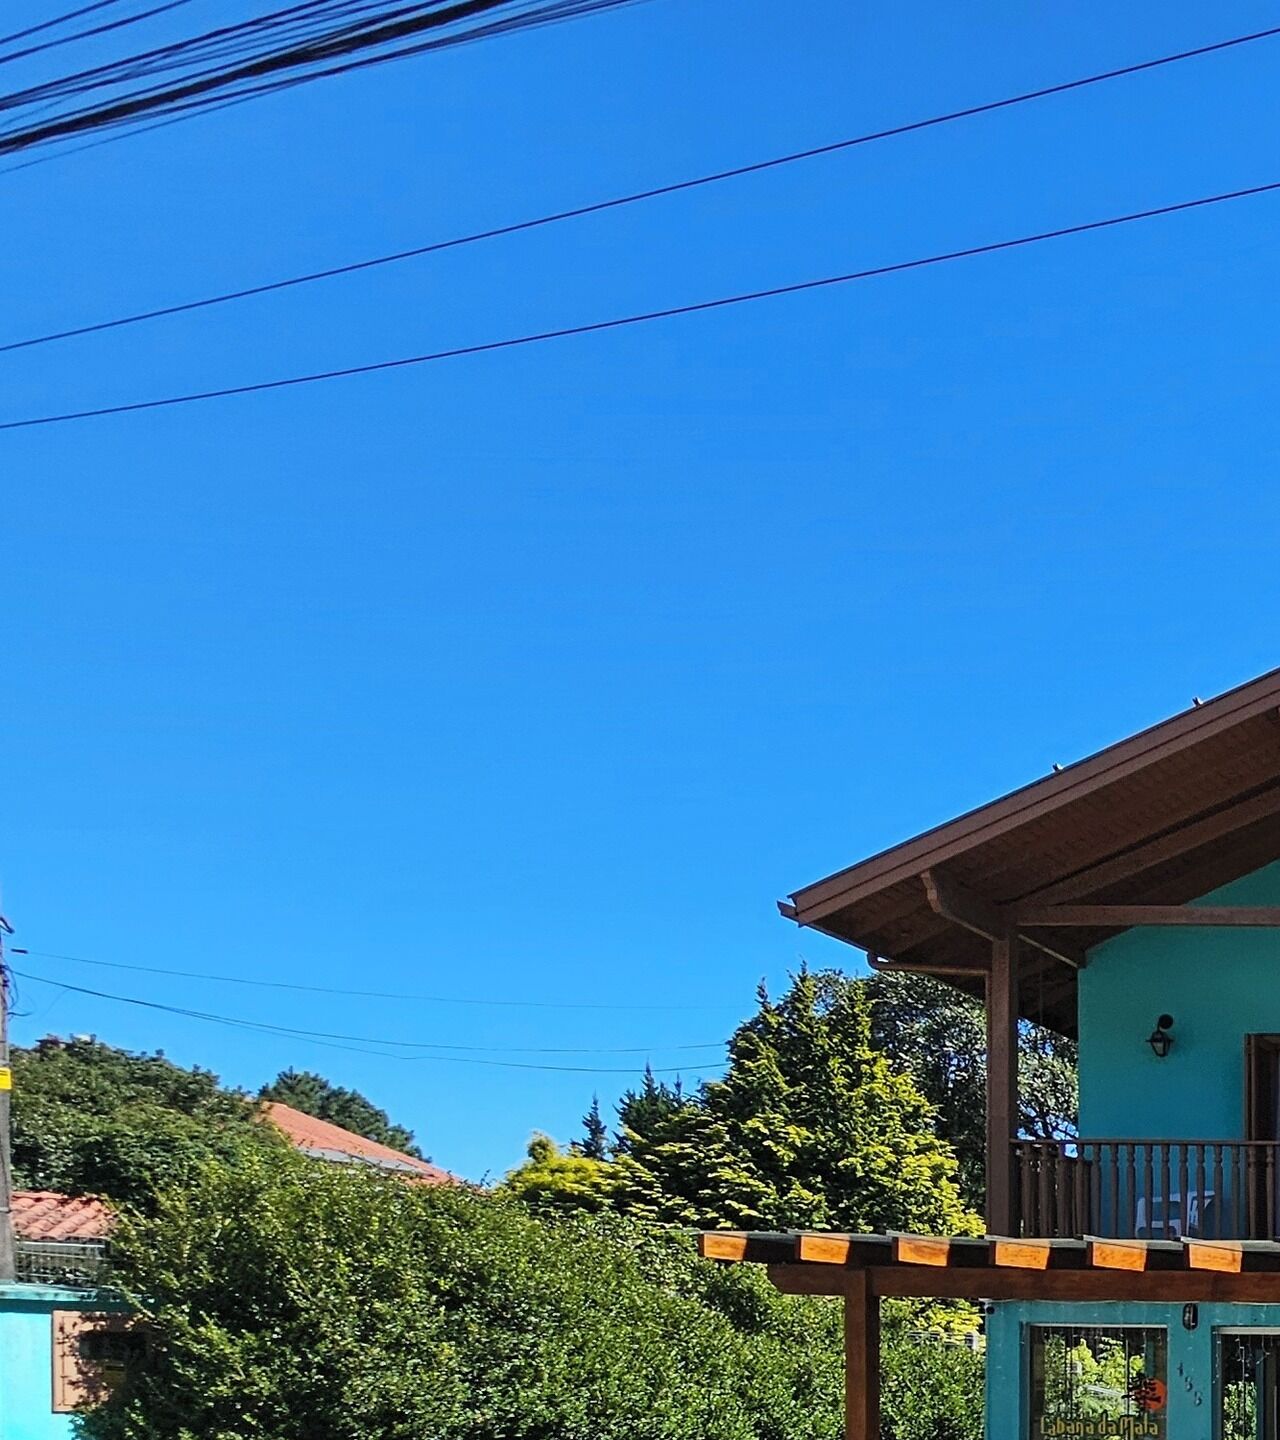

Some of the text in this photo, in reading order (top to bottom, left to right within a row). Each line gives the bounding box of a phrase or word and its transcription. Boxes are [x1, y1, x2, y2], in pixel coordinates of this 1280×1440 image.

[1040, 1412, 1159, 1440] Cabana da Mata
